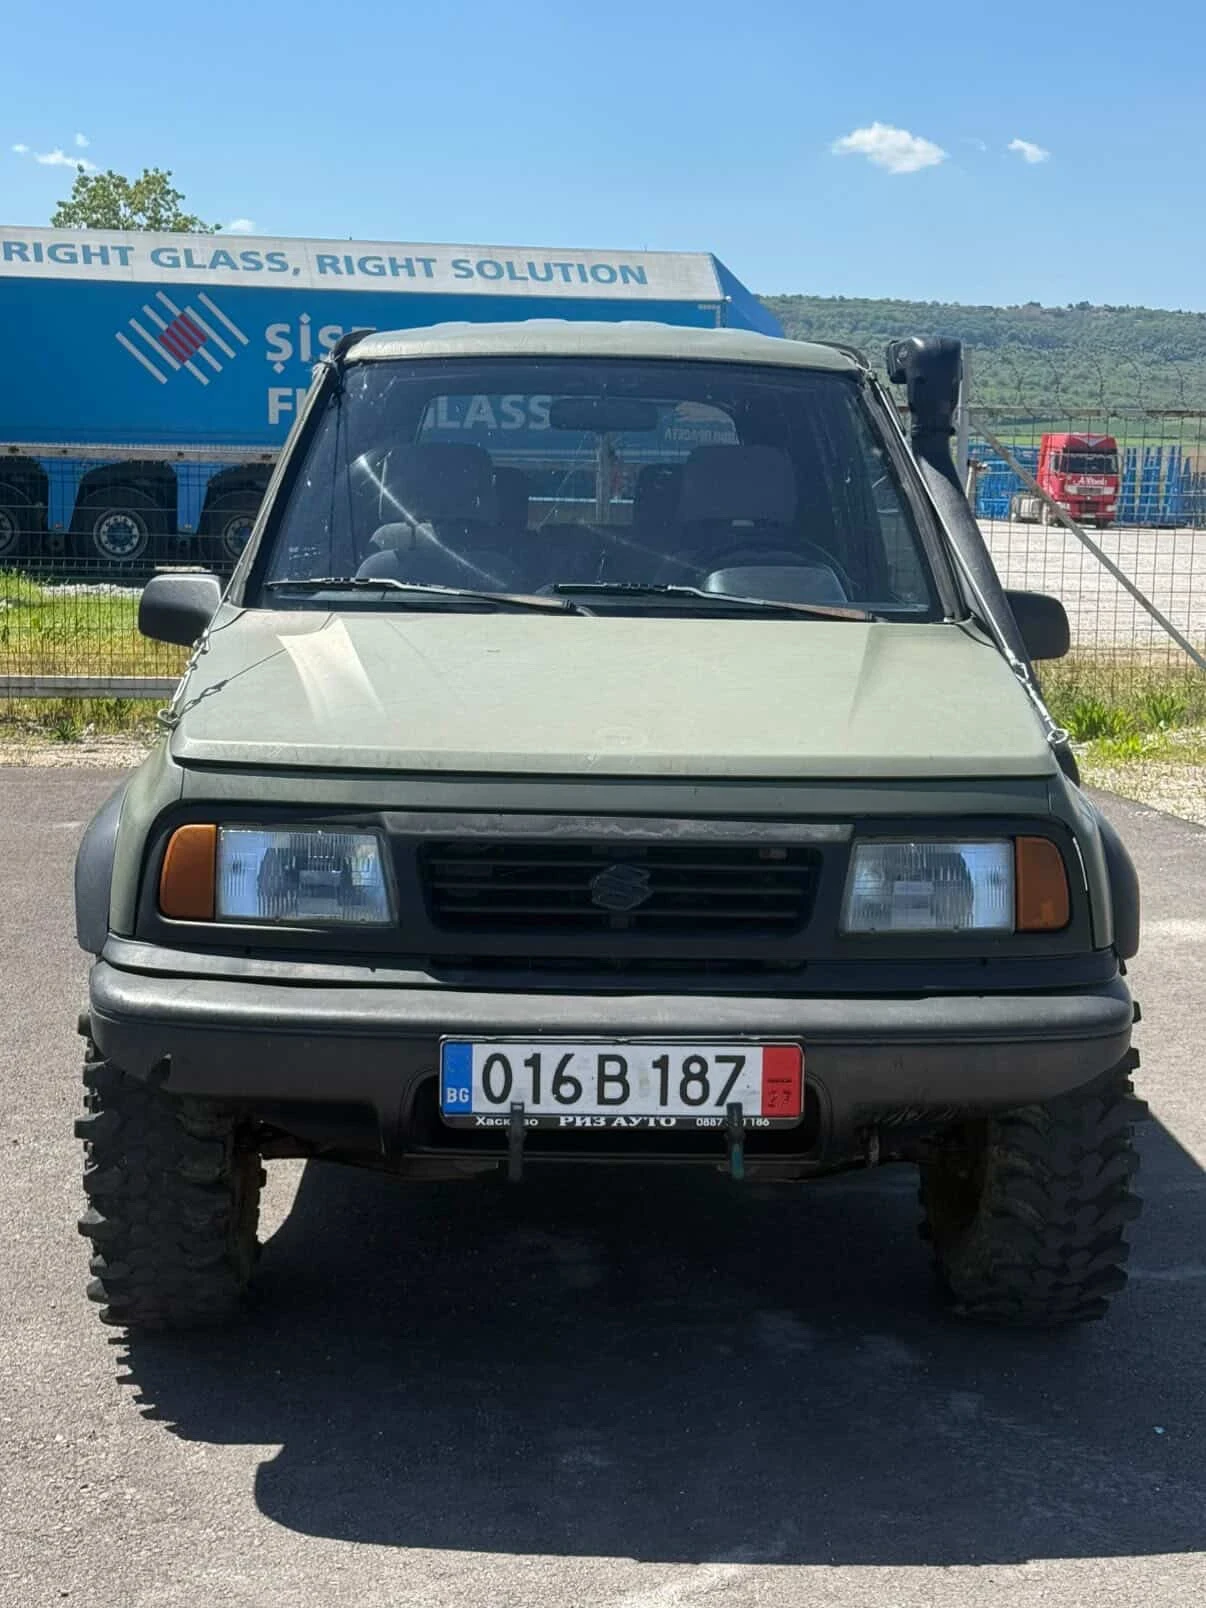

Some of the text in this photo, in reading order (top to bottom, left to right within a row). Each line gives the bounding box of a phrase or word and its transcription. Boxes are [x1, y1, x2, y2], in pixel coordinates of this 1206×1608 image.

[2, 240, 648, 285] RIGHT GLASS, RIGHT SOLUTION
[265, 312, 377, 373] ŞİS
[446, 1087, 470, 1104] BG
[482, 1052, 747, 1107] 016 B 187
[559, 1115, 677, 1127] РИЗ АУТО
